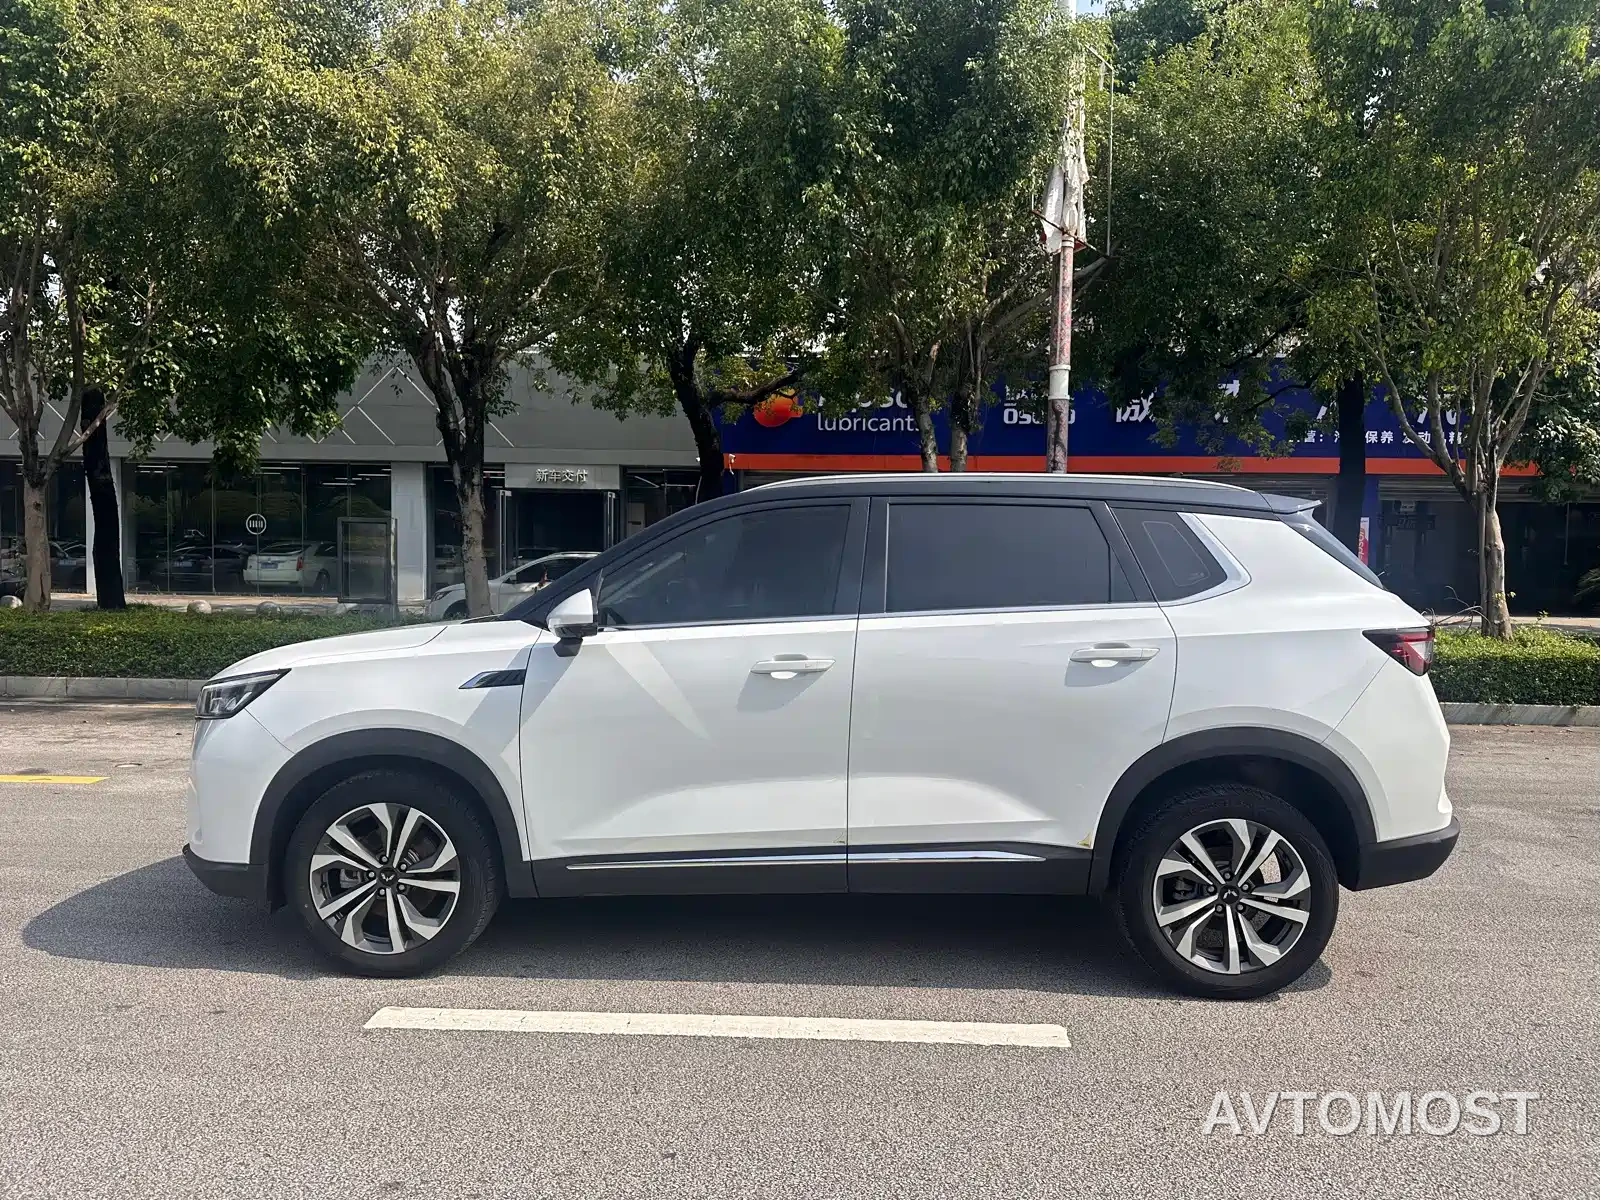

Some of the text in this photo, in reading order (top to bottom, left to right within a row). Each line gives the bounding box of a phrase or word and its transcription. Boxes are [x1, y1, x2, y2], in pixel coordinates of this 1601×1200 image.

[817, 411, 920, 432] lubricant
[535, 468, 588, 482] 新车交付
